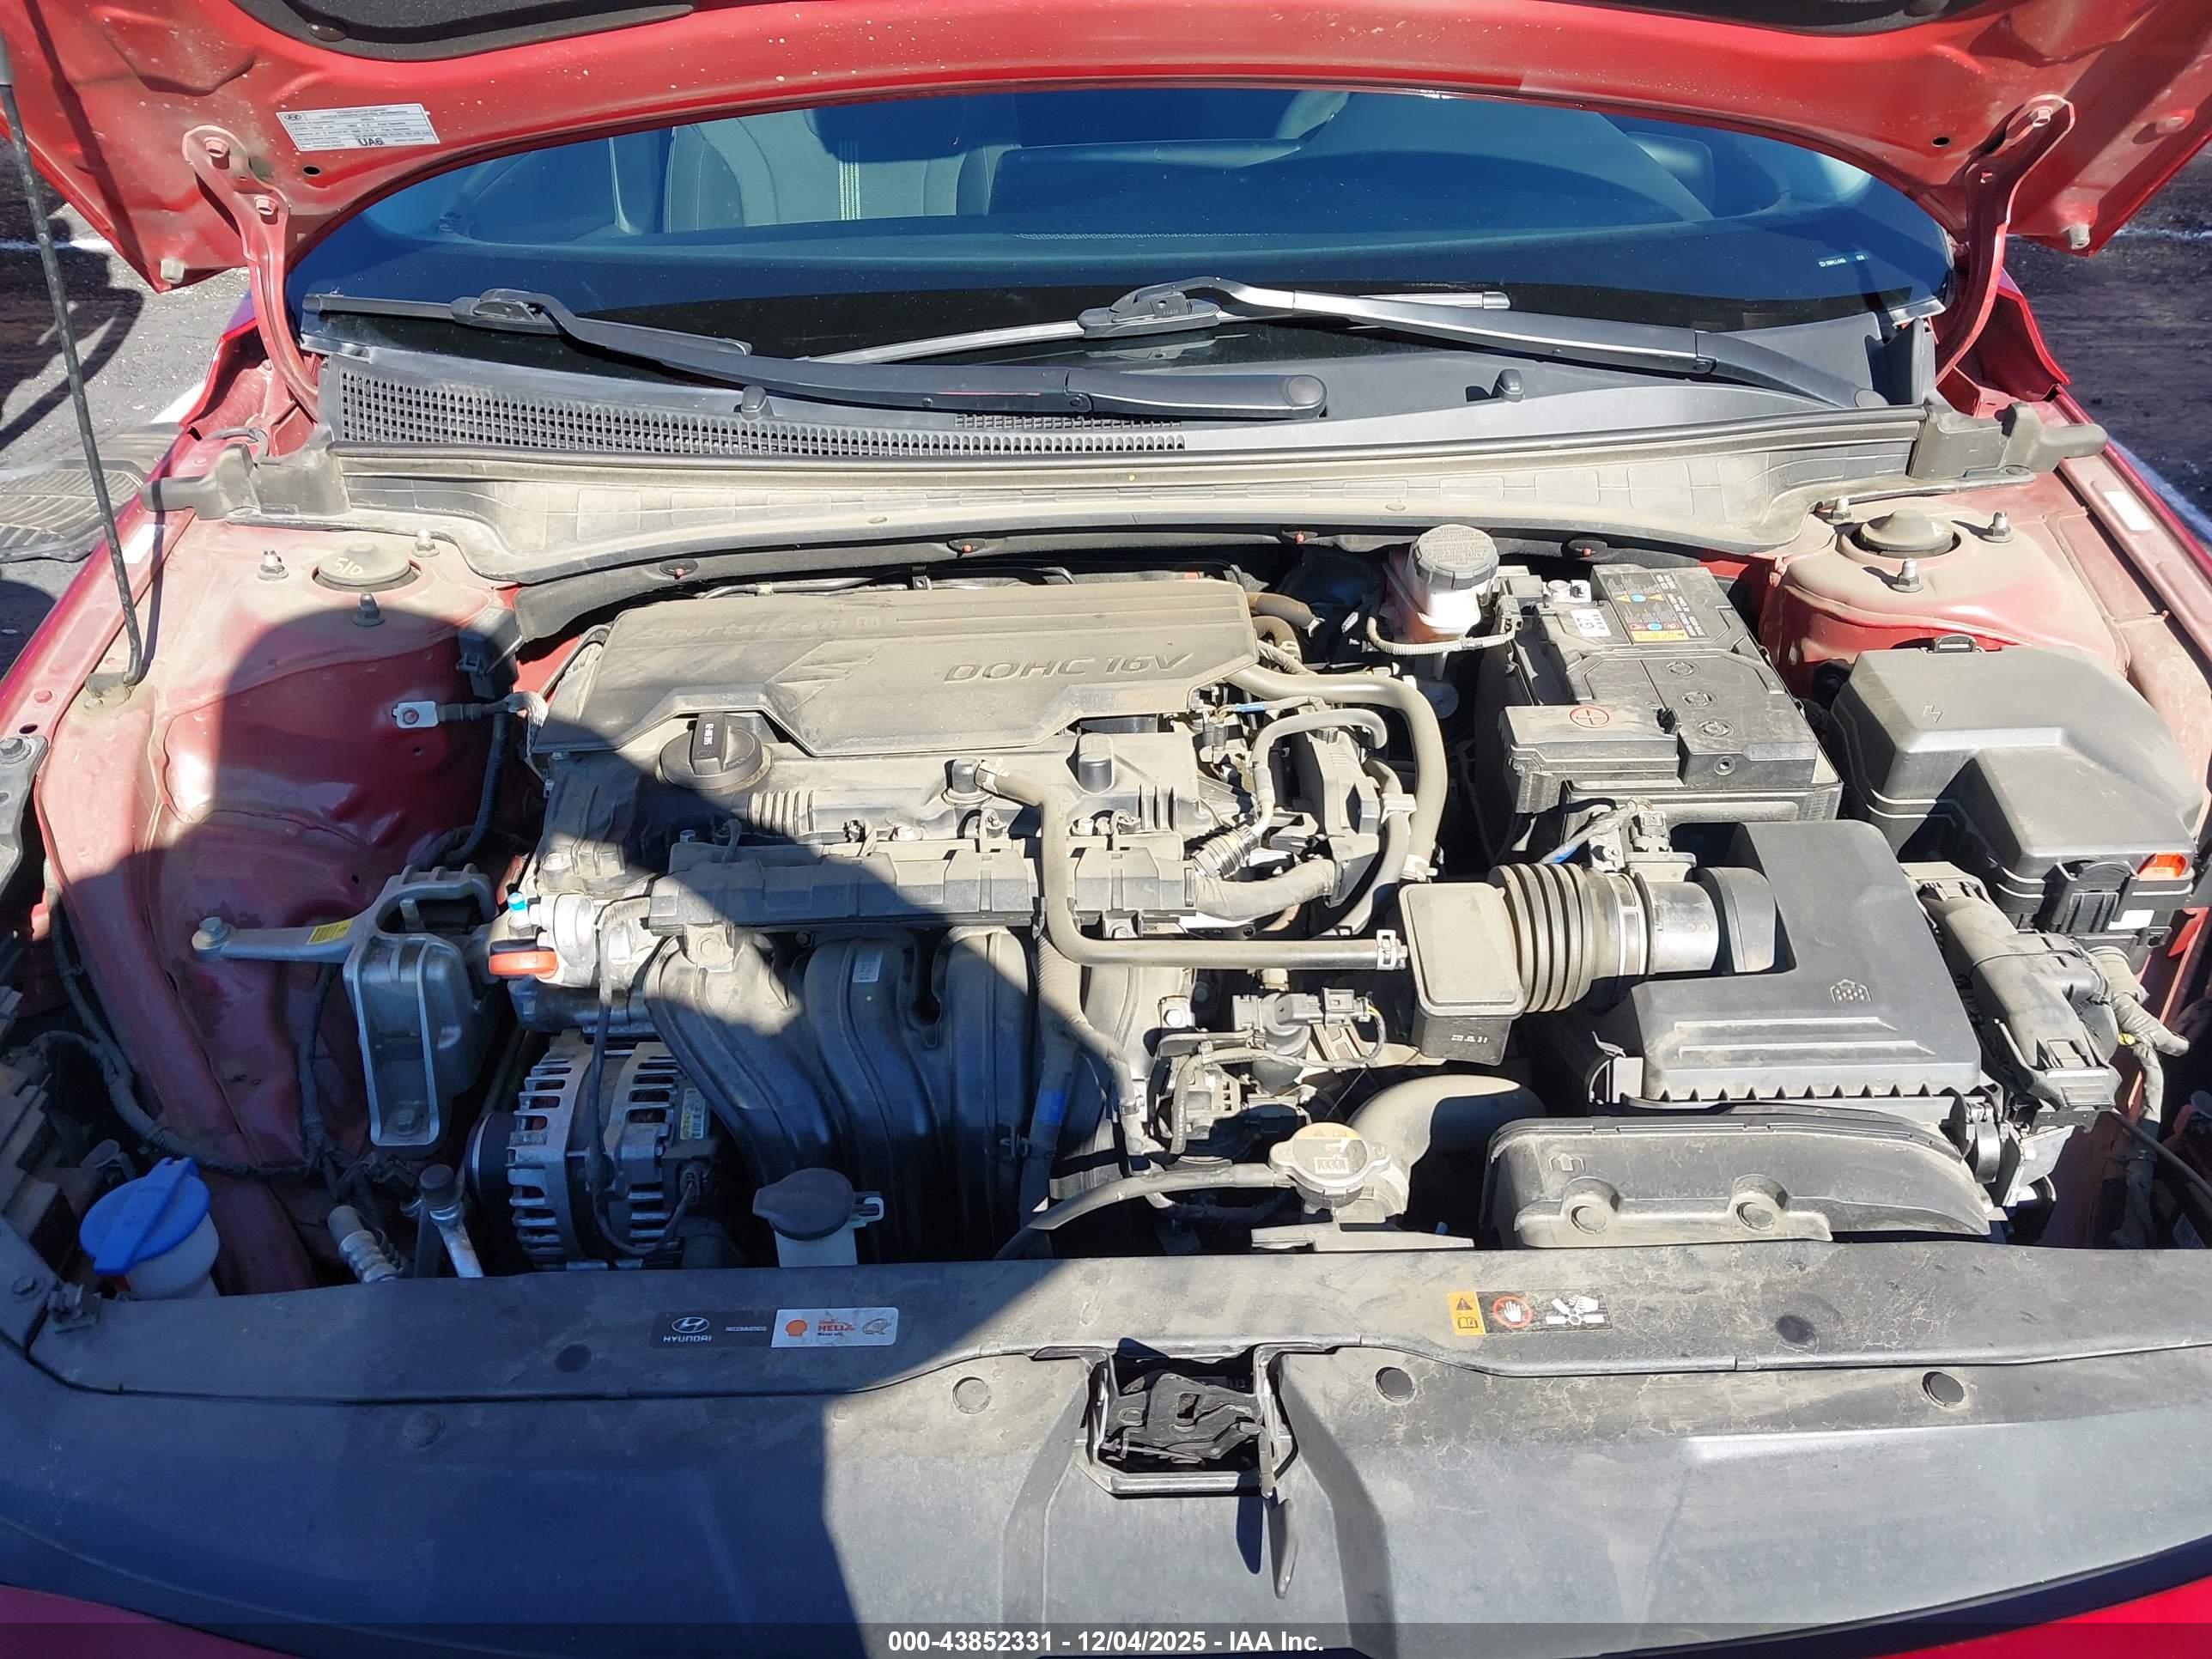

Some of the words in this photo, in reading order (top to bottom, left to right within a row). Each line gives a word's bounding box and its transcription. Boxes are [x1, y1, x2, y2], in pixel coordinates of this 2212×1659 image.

[357, 137, 385, 147] UA6
[944, 657, 1096, 683] DOHC
[1105, 652, 1194, 674] 16V
[663, 1334, 712, 1343] HYUNDAI
